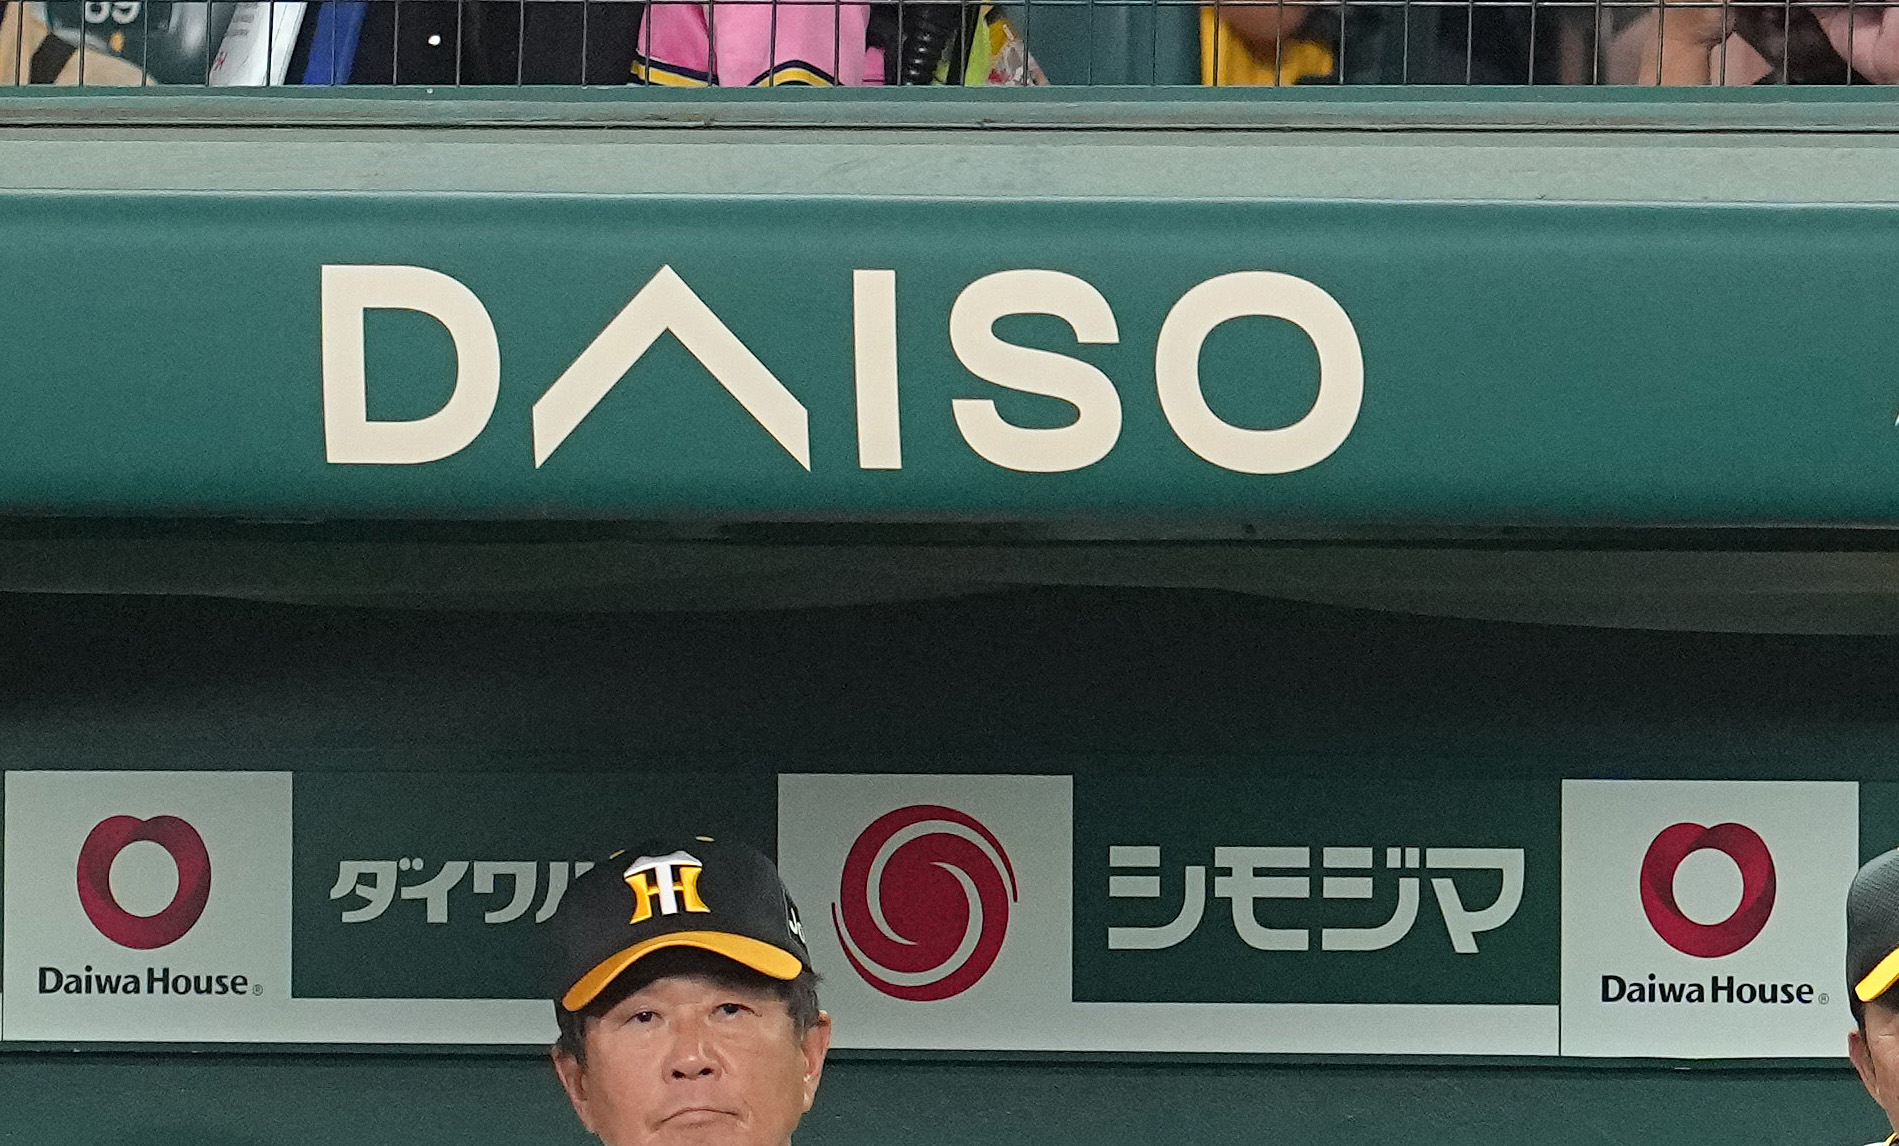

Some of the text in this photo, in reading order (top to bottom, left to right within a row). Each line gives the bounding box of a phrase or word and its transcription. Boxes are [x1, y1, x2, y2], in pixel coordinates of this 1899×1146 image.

[321, 264, 1365, 474] DAISO
[1108, 845, 1525, 954] シモジマ
[38, 964, 249, 995] Daiwa House
[1601, 973, 1815, 1004] Daiwa House
